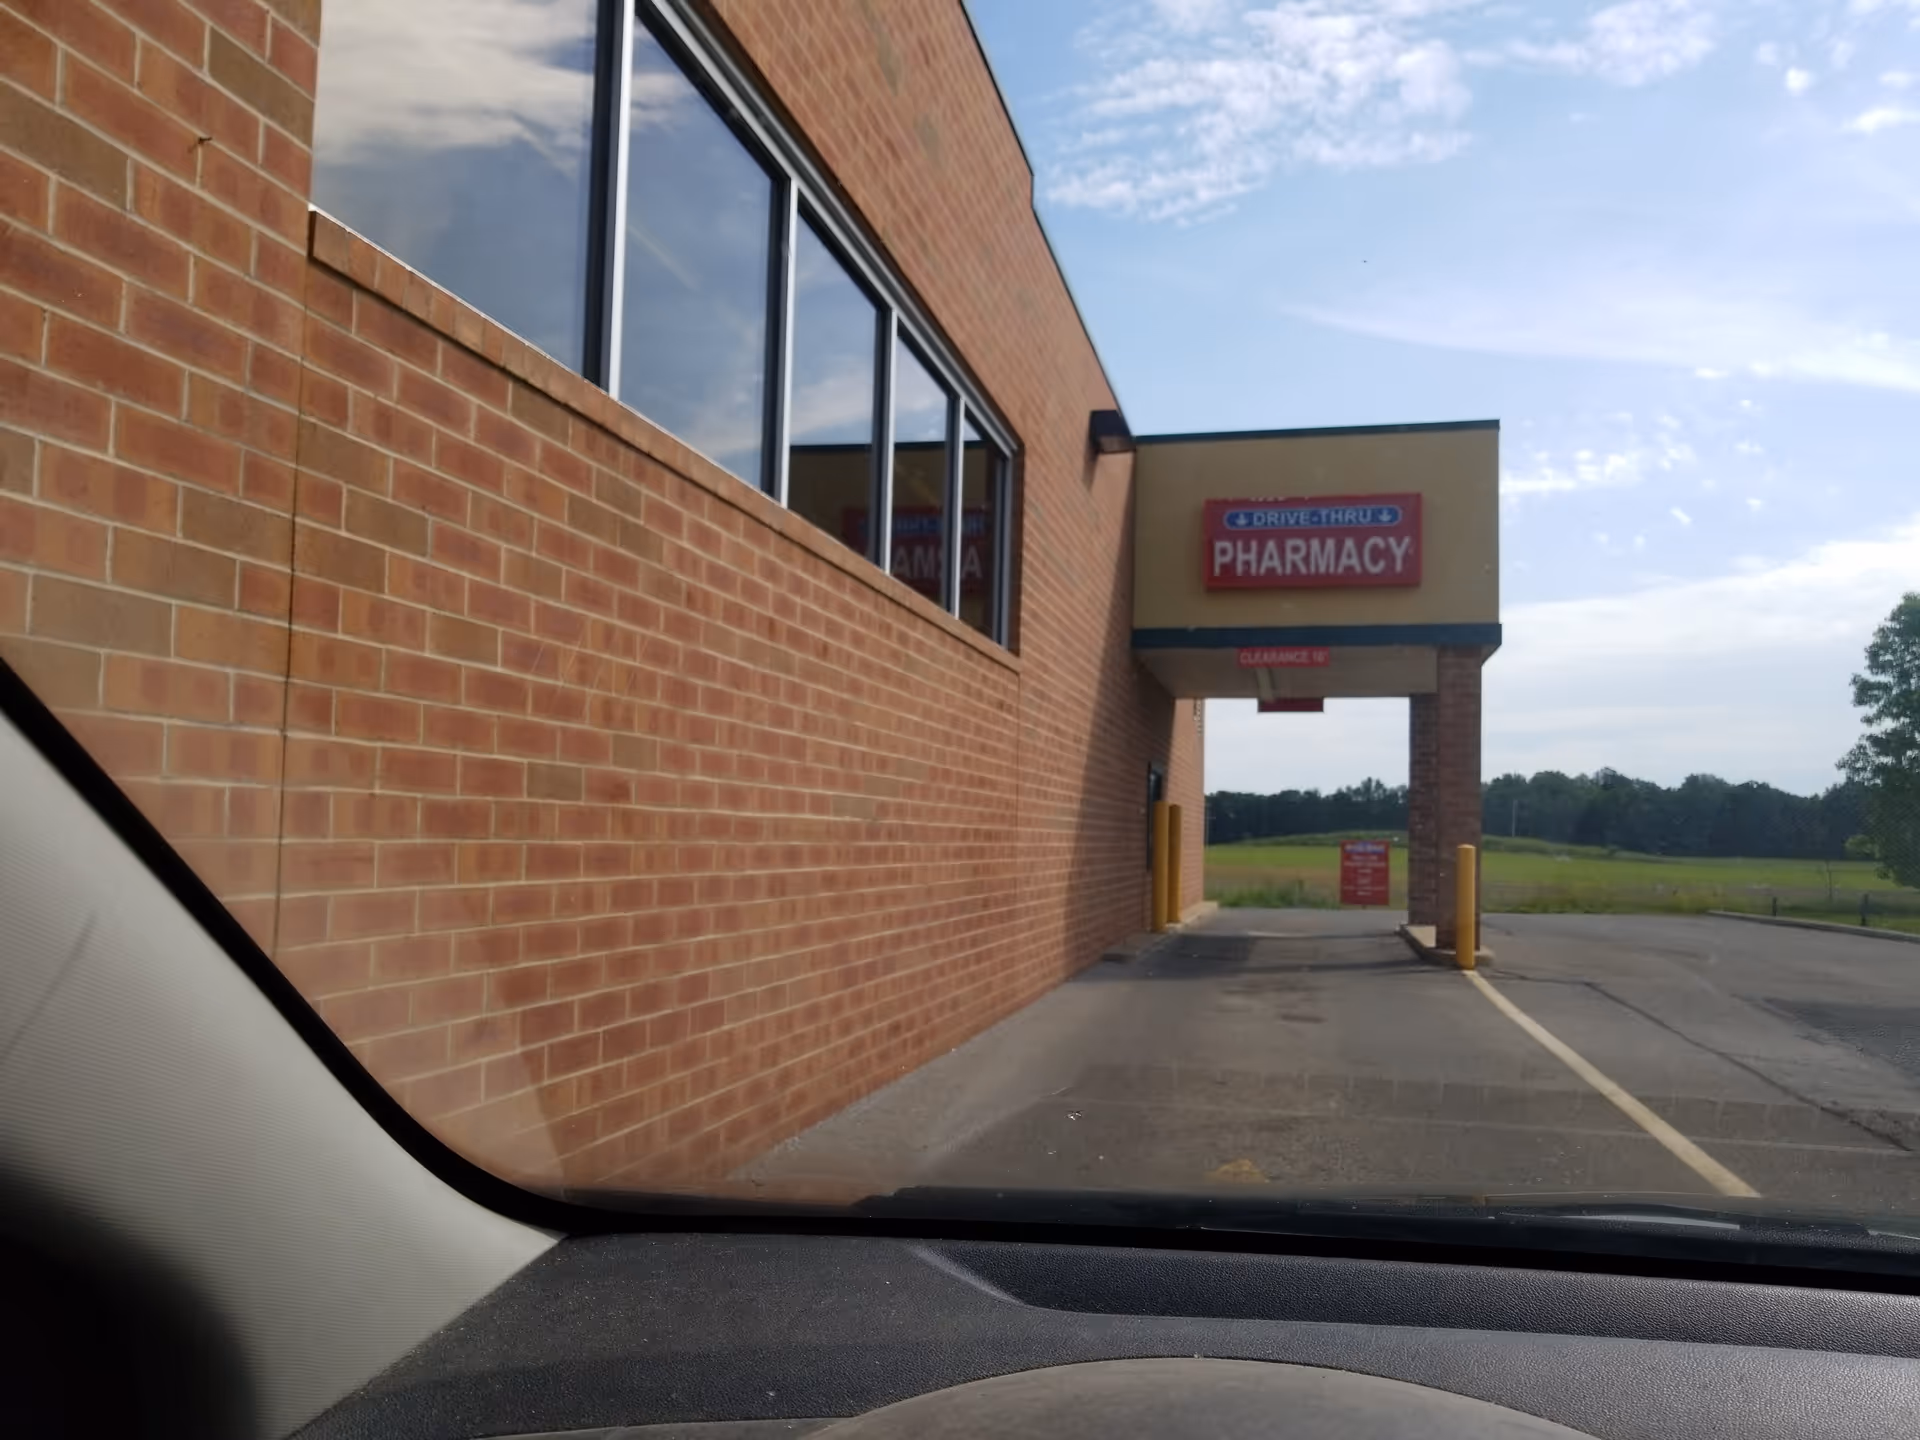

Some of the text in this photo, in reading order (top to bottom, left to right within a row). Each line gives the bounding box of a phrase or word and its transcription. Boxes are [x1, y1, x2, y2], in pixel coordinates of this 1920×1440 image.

[1252, 508, 1373, 527] DRIVE-THRU
[1213, 536, 1411, 576] PHARMACY
[1240, 651, 1308, 664] CLEARANCE
